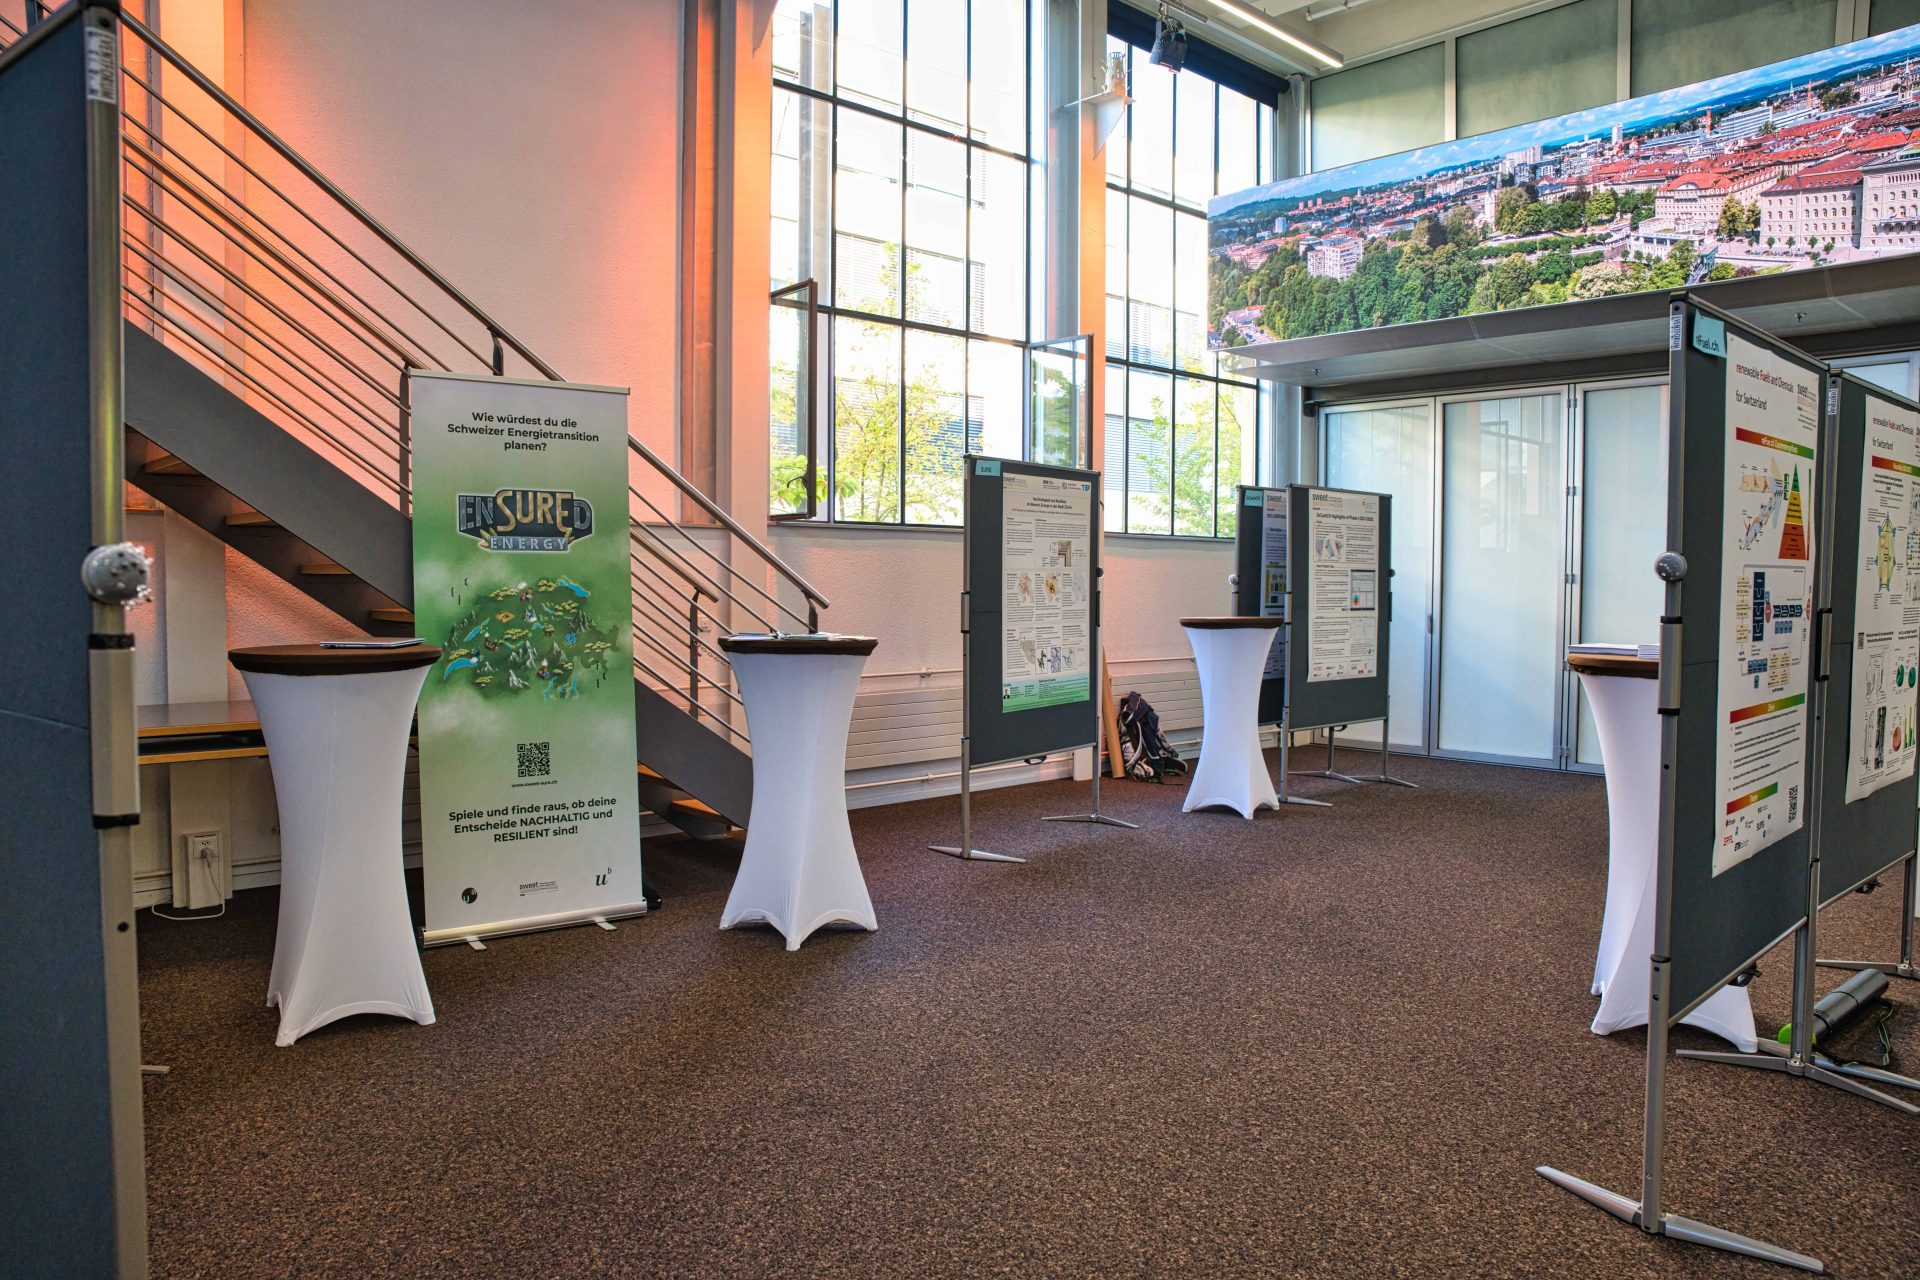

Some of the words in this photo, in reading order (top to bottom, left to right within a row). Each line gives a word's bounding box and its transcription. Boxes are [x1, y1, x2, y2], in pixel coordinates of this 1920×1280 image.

[1736, 364, 1759, 380] renewable
[1760, 370, 1770, 383] Fuels
[1778, 378, 1794, 393] Chemicals
[1743, 393, 1767, 410] Switzerland
[472, 412, 494, 422] Wie
[497, 415, 541, 426] würdest
[544, 418, 557, 427] du
[560, 418, 577, 428] die
[447, 424, 504, 436] Schweizer
[507, 429, 599, 442] Energietransition
[504, 441, 546, 452] planen?
[490, 537, 567, 550] ENERGY
[511, 780, 558, 788] www.sweet-sure.ch
[449, 810, 484, 822] Spiele
[487, 806, 509, 817] und
[512, 804, 541, 814] finde
[543, 802, 569, 812] raus,
[571, 798, 585, 809] ob
[587, 797, 616, 807] deine
[454, 819, 517, 834] Entscheide
[520, 812, 590, 827] NACHHALTIG
[592, 810, 613, 819] und
[494, 829, 550, 843] RESILIENT
[552, 826, 578, 837] sind!
[519, 882, 538, 890] sweet
